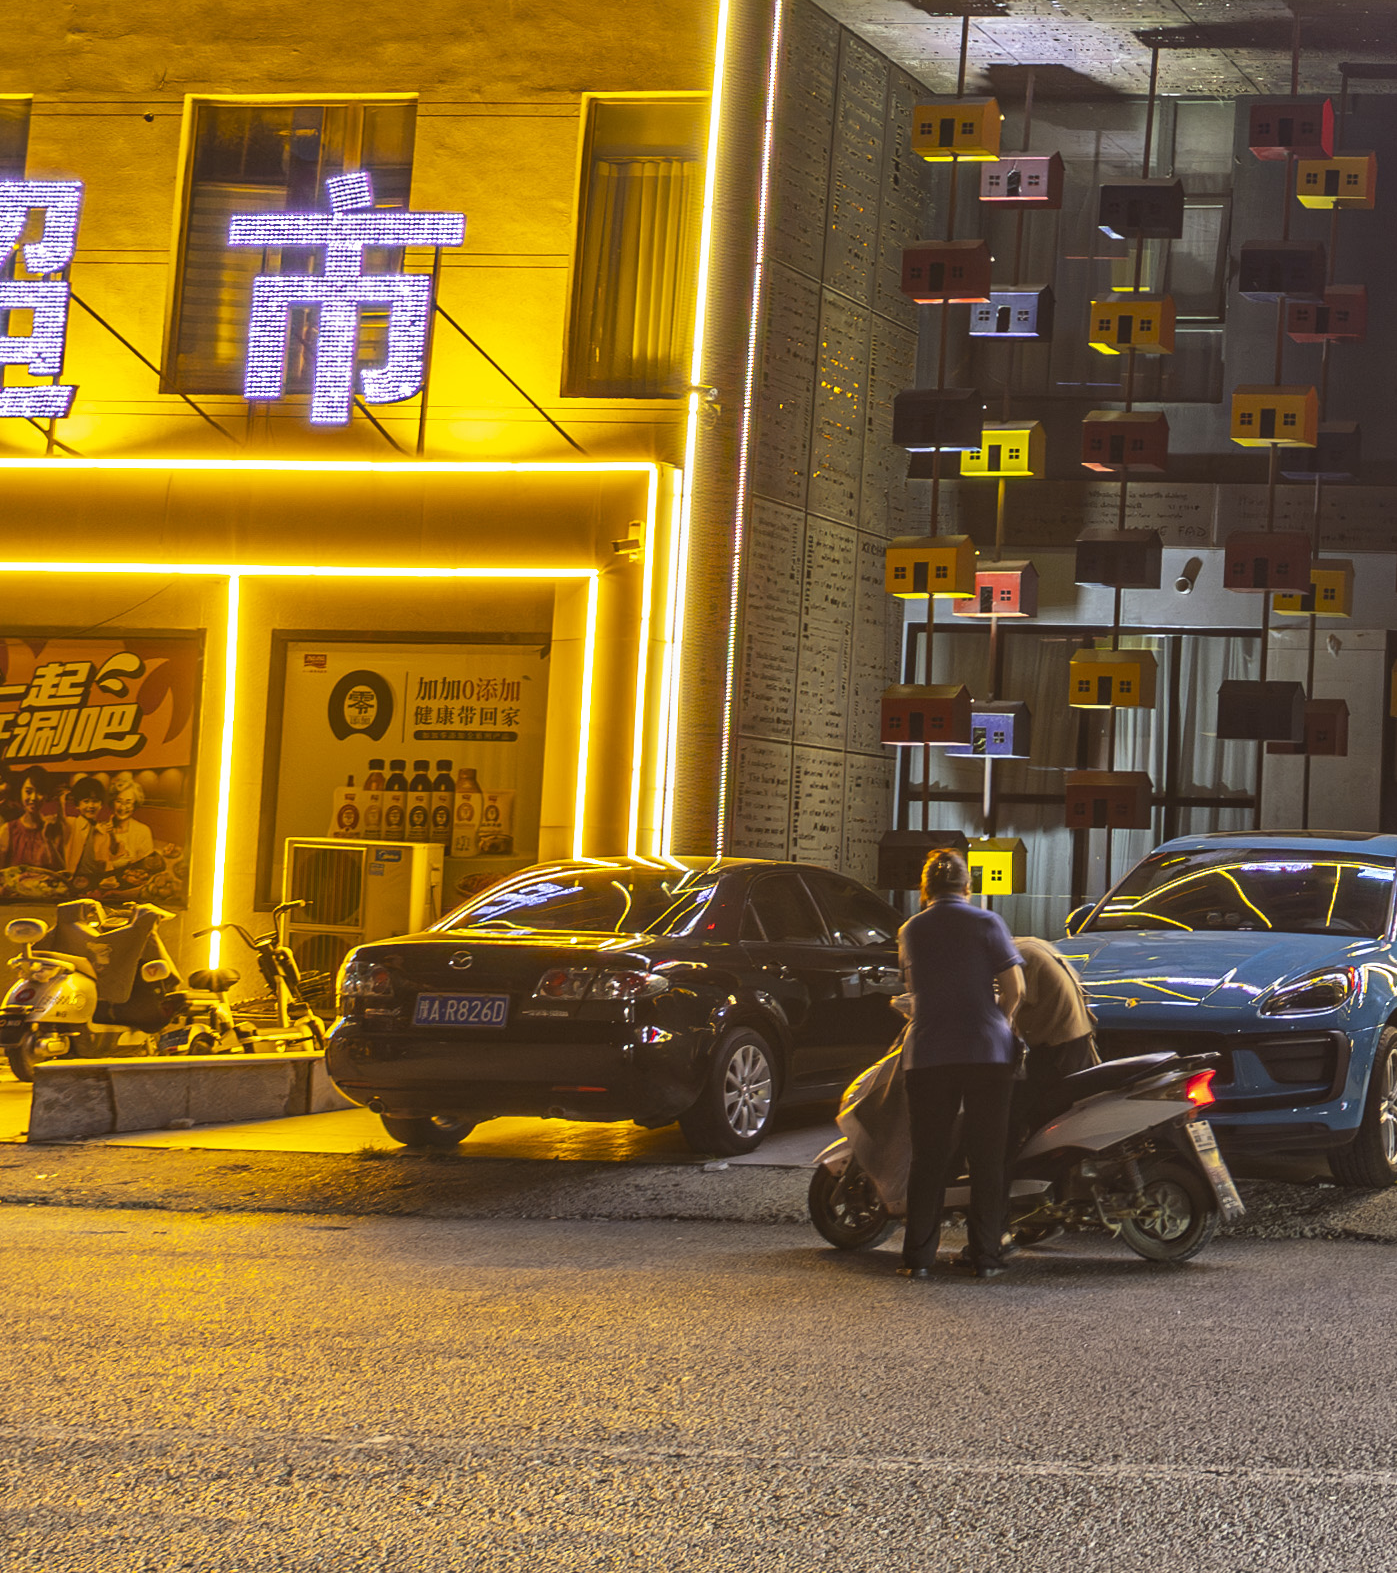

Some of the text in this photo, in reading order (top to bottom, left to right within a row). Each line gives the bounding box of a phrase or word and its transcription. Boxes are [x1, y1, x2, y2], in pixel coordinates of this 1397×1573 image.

[347, 690, 375, 715] 零
[415, 676, 523, 703] 加加0添加
[414, 705, 521, 727] 健康带回家
[0, 703, 143, 759] 涮吧
